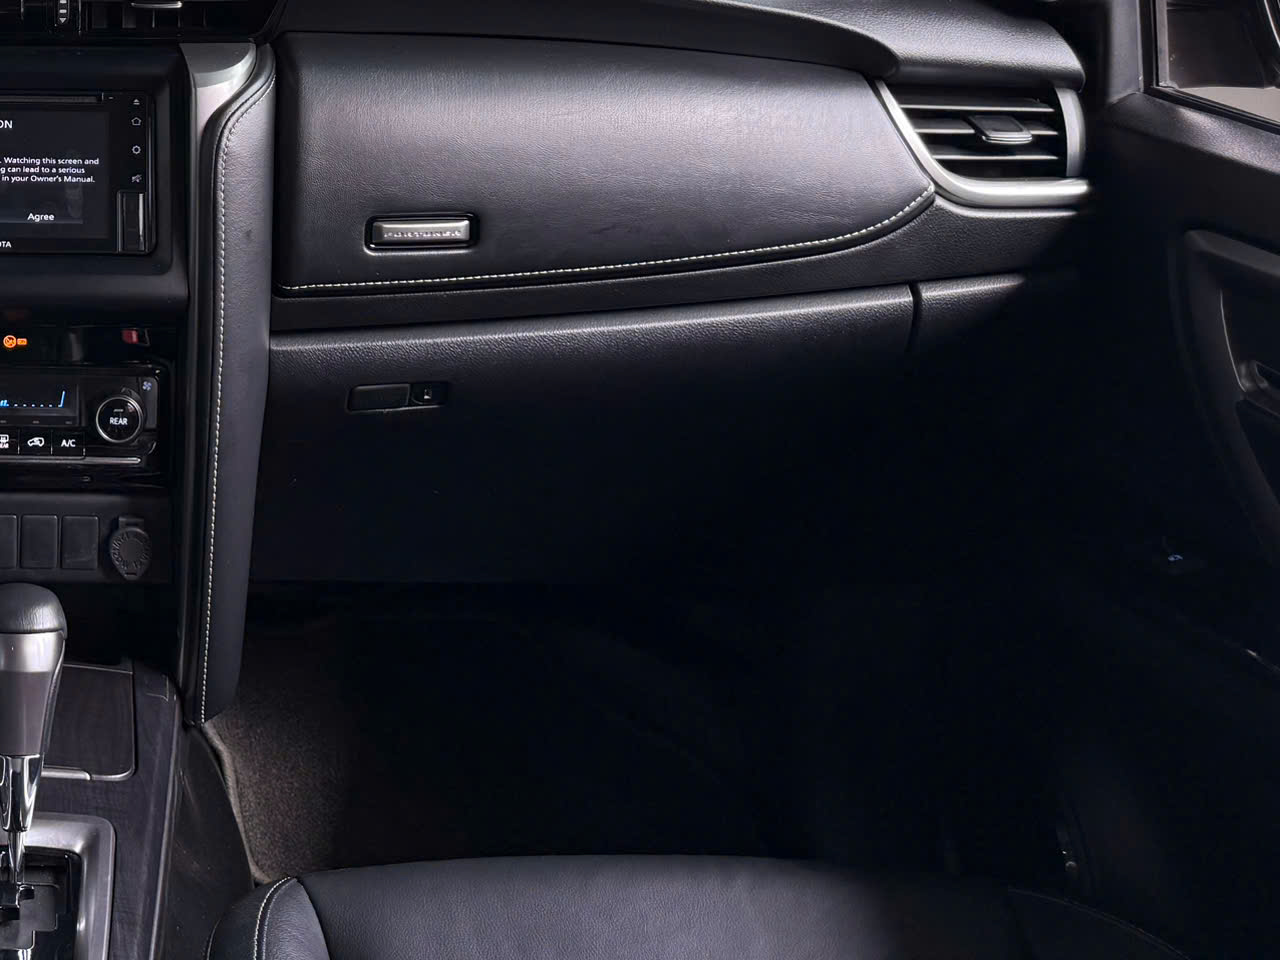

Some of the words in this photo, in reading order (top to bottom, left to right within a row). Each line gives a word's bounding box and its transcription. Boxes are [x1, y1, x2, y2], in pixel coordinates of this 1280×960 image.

[4, 157, 41, 166] Watching
[58, 166, 86, 174] serious
[1, 174, 9, 182] in
[30, 174, 62, 183] Owner's
[63, 175, 95, 183] Manual.
[27, 212, 55, 222] Agree
[109, 417, 128, 425] REAR
[61, 439, 76, 447] A/C
